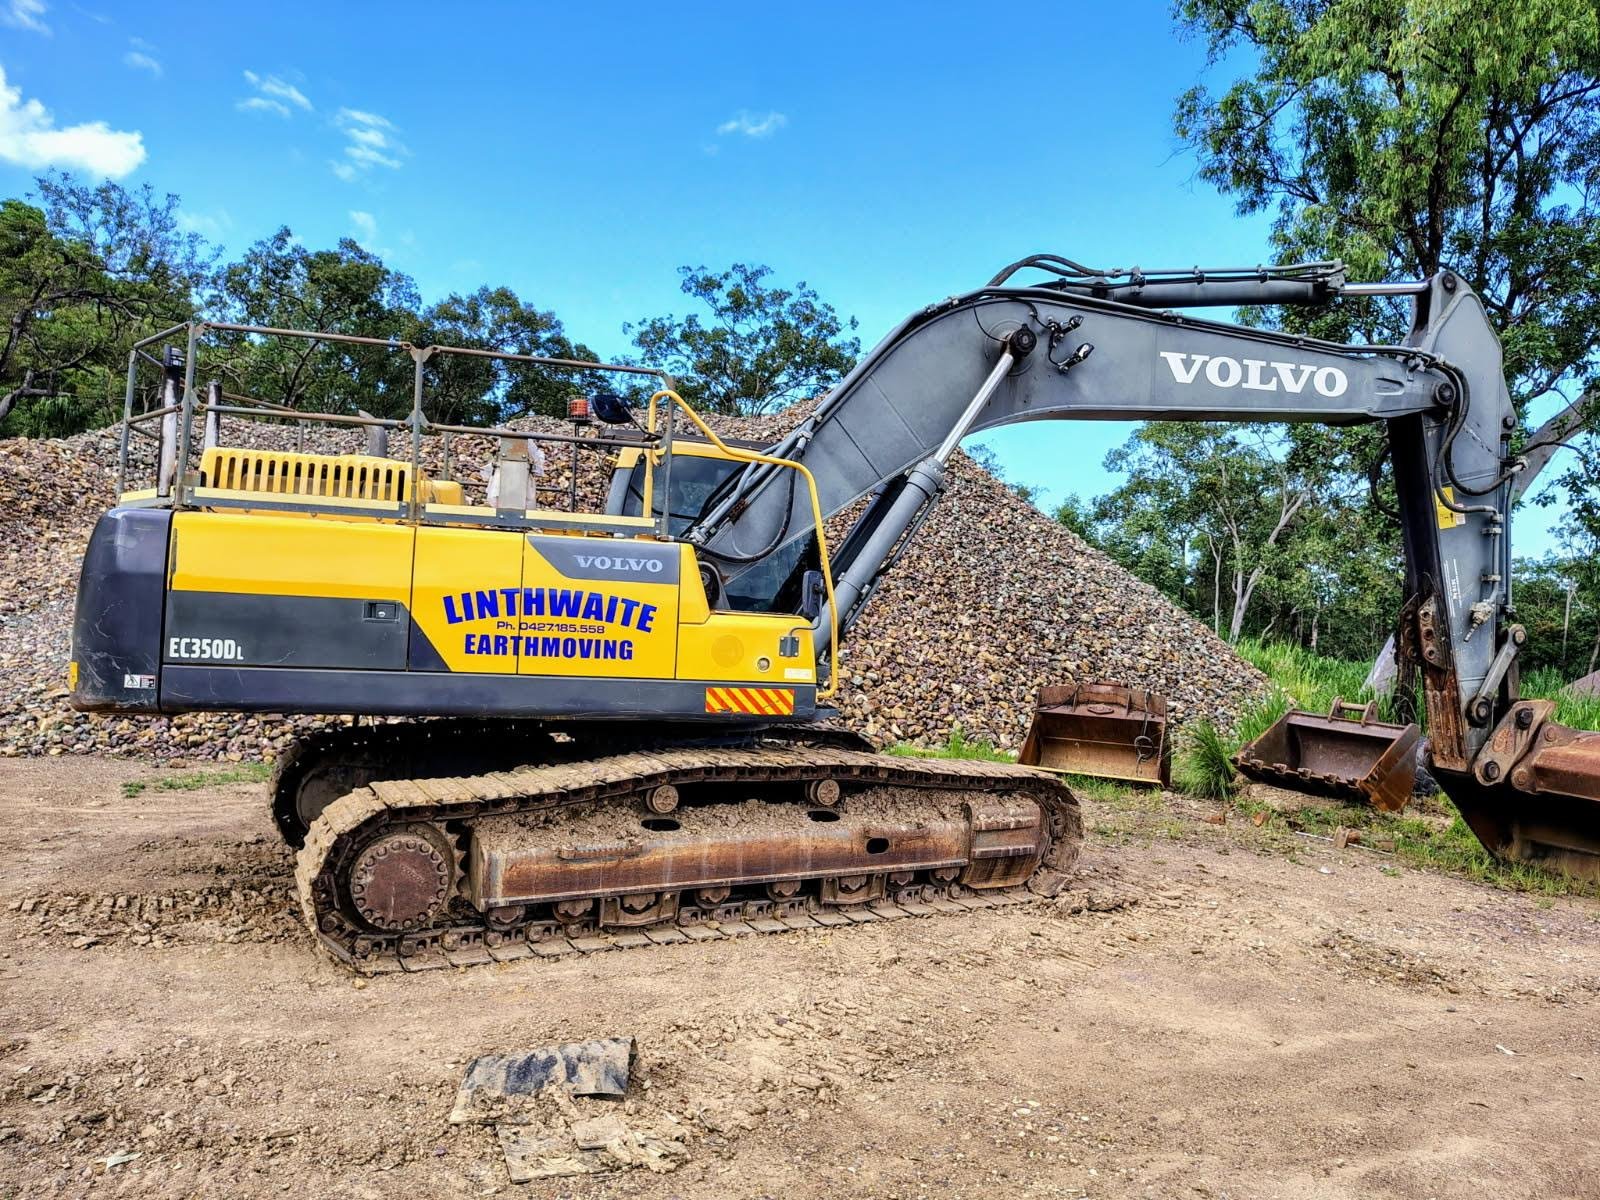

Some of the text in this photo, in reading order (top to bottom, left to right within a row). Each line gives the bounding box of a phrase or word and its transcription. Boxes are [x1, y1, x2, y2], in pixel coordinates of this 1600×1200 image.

[1160, 352, 1348, 397] VOLVO
[573, 555, 663, 573] VOLVO
[443, 587, 658, 633] LINTHWAITE
[496, 621, 516, 631] Ph.
[464, 634, 633, 660] EARTHMOVING
